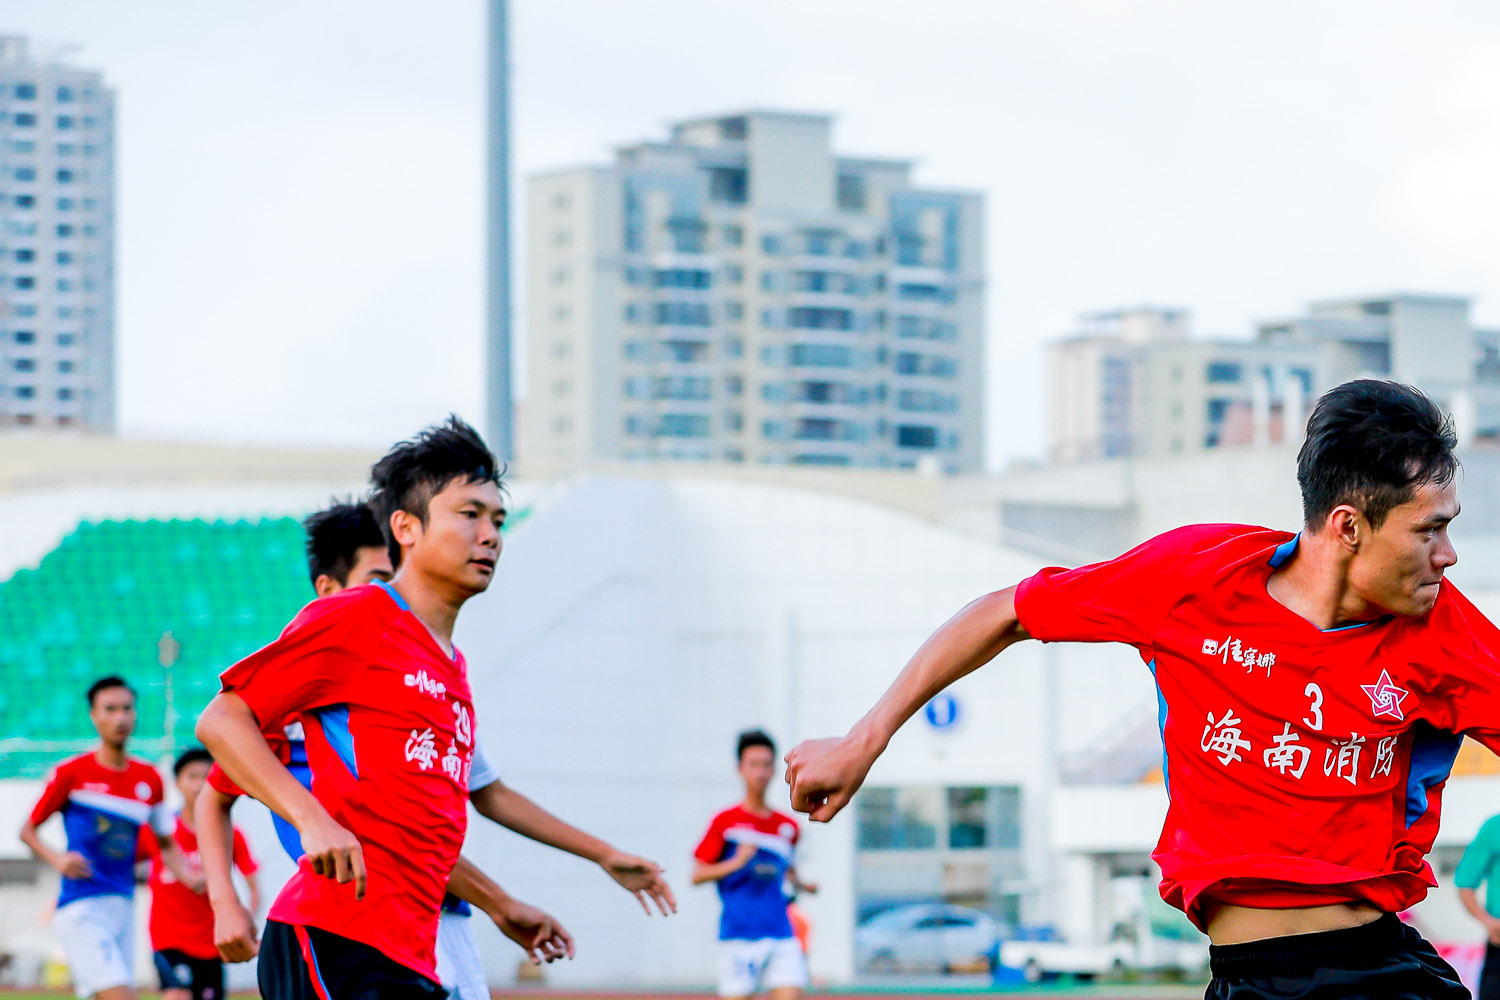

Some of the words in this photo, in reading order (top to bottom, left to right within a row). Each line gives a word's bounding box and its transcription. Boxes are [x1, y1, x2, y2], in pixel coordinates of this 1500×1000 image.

[1303, 682, 1324, 731] 3
[1201, 708, 1400, 786] 海南消防
